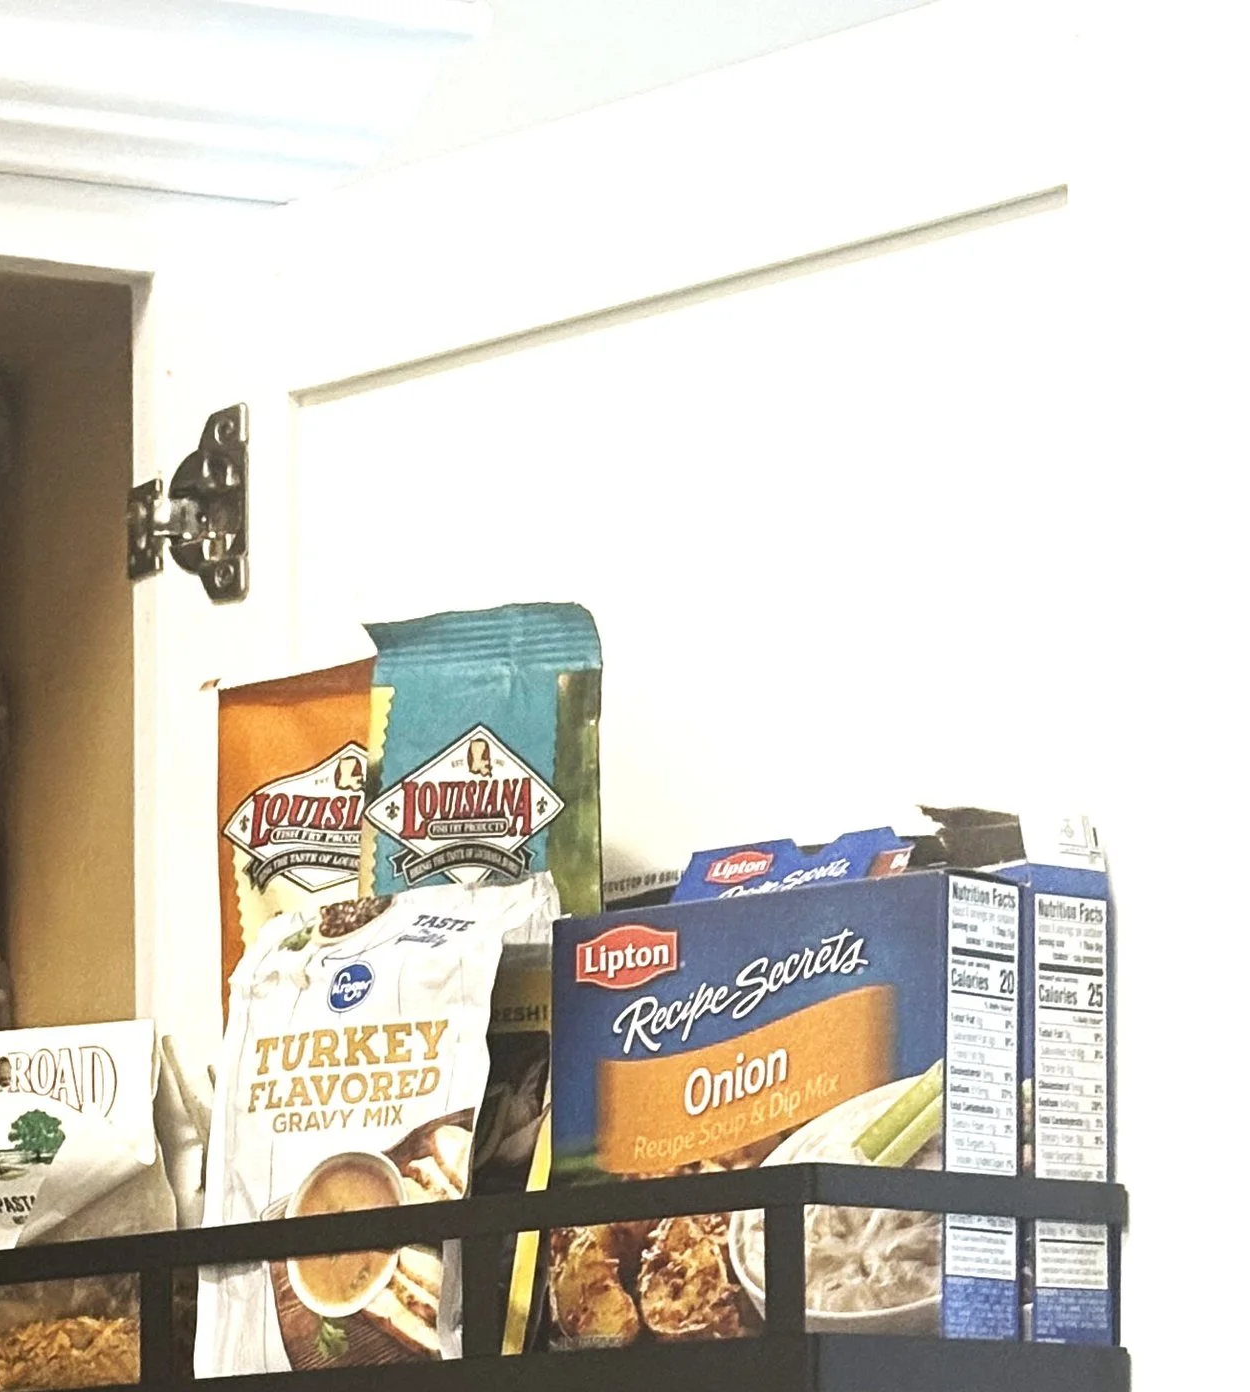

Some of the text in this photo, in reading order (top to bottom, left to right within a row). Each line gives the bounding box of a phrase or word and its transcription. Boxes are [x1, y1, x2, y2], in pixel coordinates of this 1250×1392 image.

[250, 793, 362, 848] LOUISI
[399, 777, 533, 840] LOUISIANA
[712, 859, 767, 879] Lipton
[953, 881, 1016, 909] Nutrition Facts
[1039, 899, 1077, 920] Nutrition
[1079, 902, 1104, 923] Facts
[412, 914, 476, 932] TASTE
[585, 944, 670, 979] Lipton
[951, 967, 1015, 995] Calories 20
[612, 927, 869, 1054] Recipe Secrets
[1038, 982, 1103, 1008] Calories 25
[255, 1020, 449, 1076] TURKEY
[9, 1045, 117, 1118] ROAD
[247, 1066, 441, 1114] FLAVORED
[683, 1047, 788, 1117] Onion
[272, 1104, 403, 1134] GRAVY MIX
[633, 1071, 840, 1161] Recipe Soup & Dip Mix
